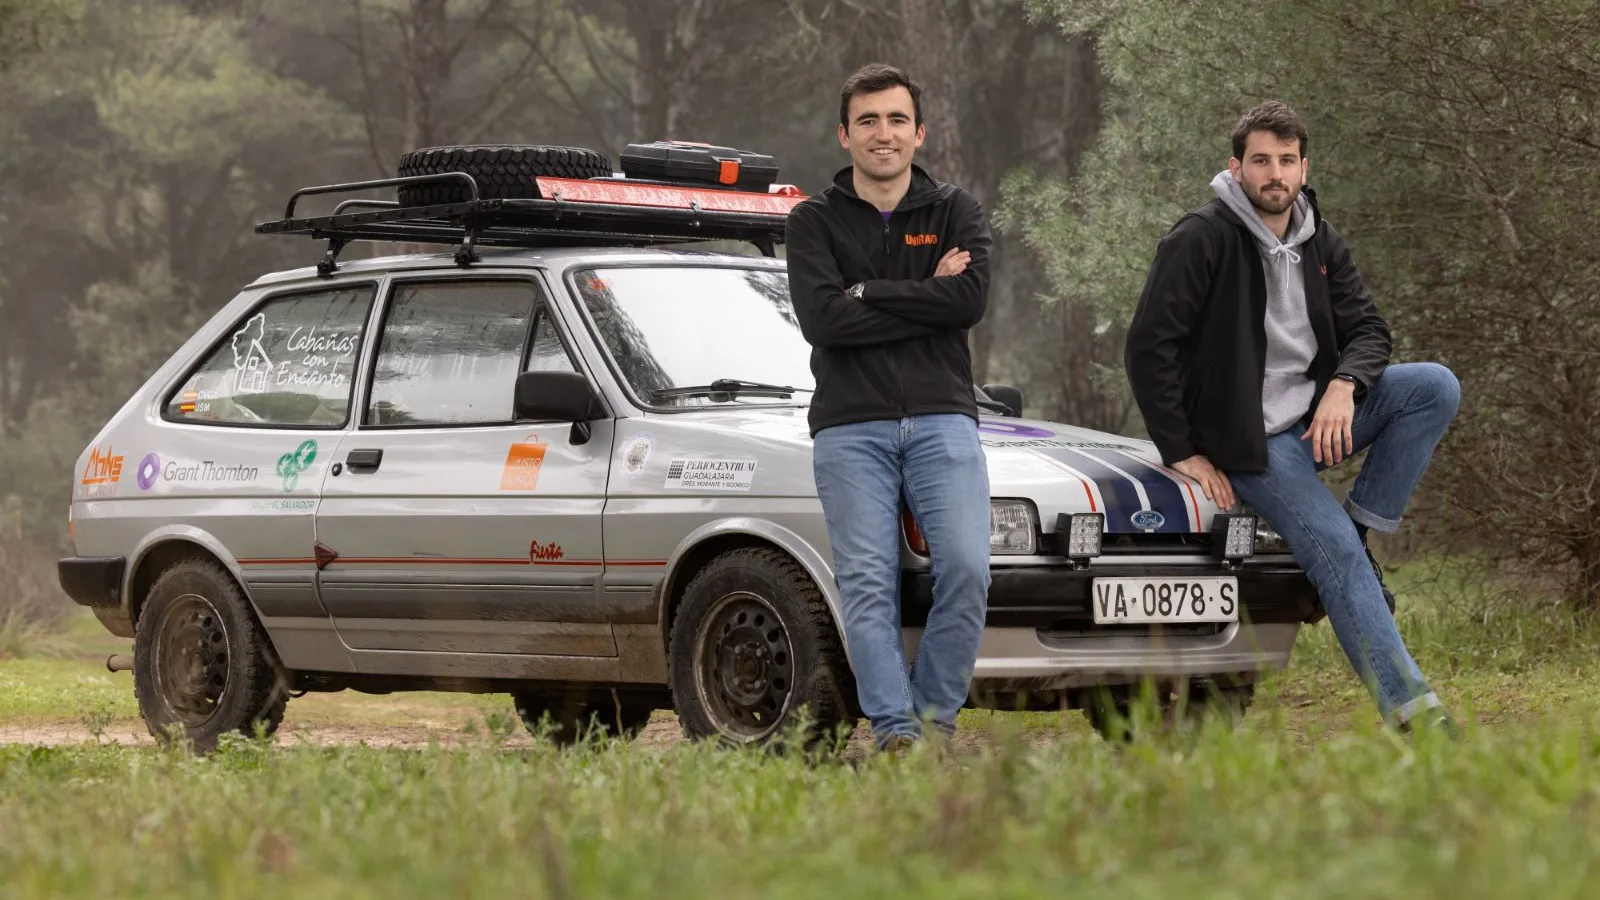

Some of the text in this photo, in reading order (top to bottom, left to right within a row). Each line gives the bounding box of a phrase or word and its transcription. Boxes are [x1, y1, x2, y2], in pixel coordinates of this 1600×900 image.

[287, 326, 359, 357] Cabañas
[302, 355, 329, 367] con
[276, 357, 346, 387] Encanto
[163, 460, 258, 482] Grant Thornton
[686, 460, 756, 472] PERIOCENTRUM
[683, 472, 735, 480] GUADALAJARA
